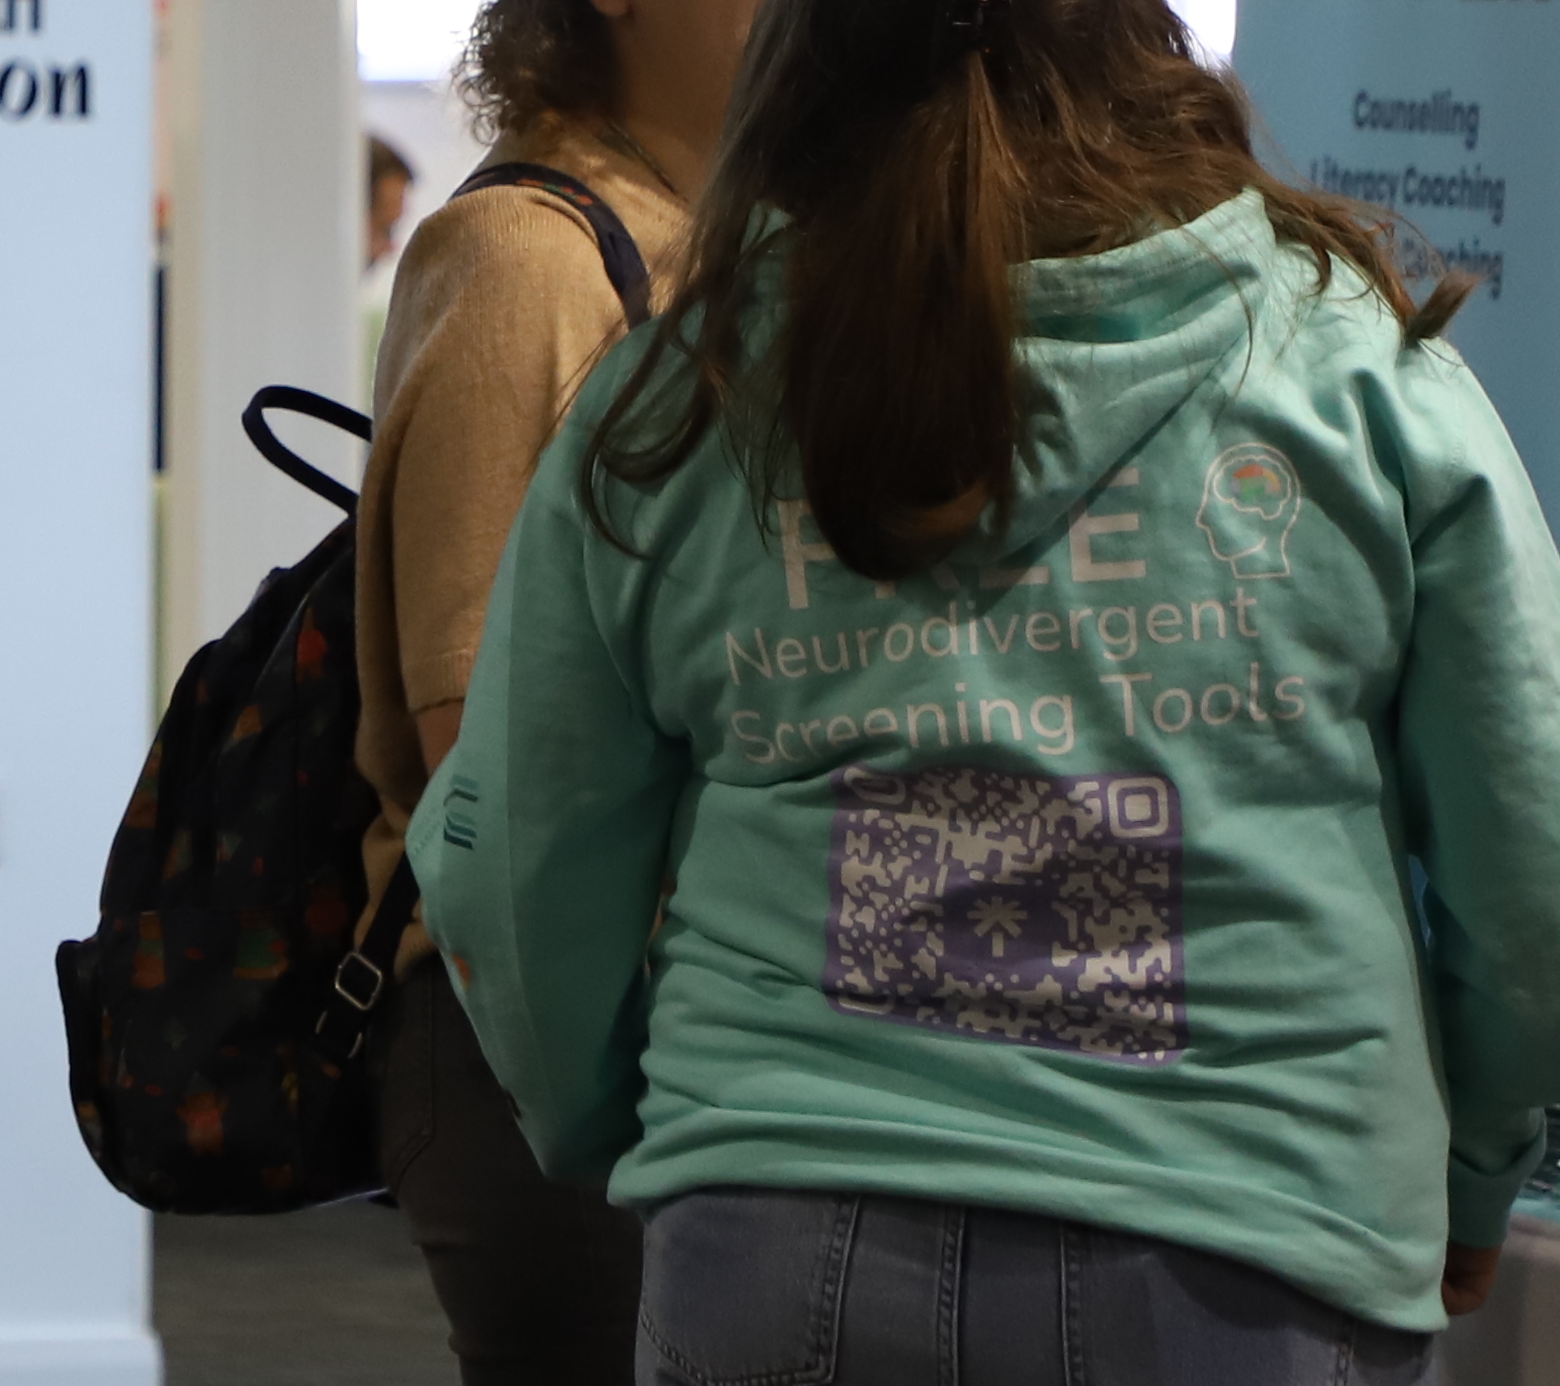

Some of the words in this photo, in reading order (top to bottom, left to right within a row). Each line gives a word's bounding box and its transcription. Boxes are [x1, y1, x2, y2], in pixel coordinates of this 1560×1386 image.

[1353, 88, 1480, 151] Counselling
[1402, 162, 1506, 227] Coaching
[778, 466, 1149, 610] FE
[725, 587, 1263, 686] Neurodivergent
[730, 682, 1077, 764] Screening
[1100, 661, 1308, 739] Tools
